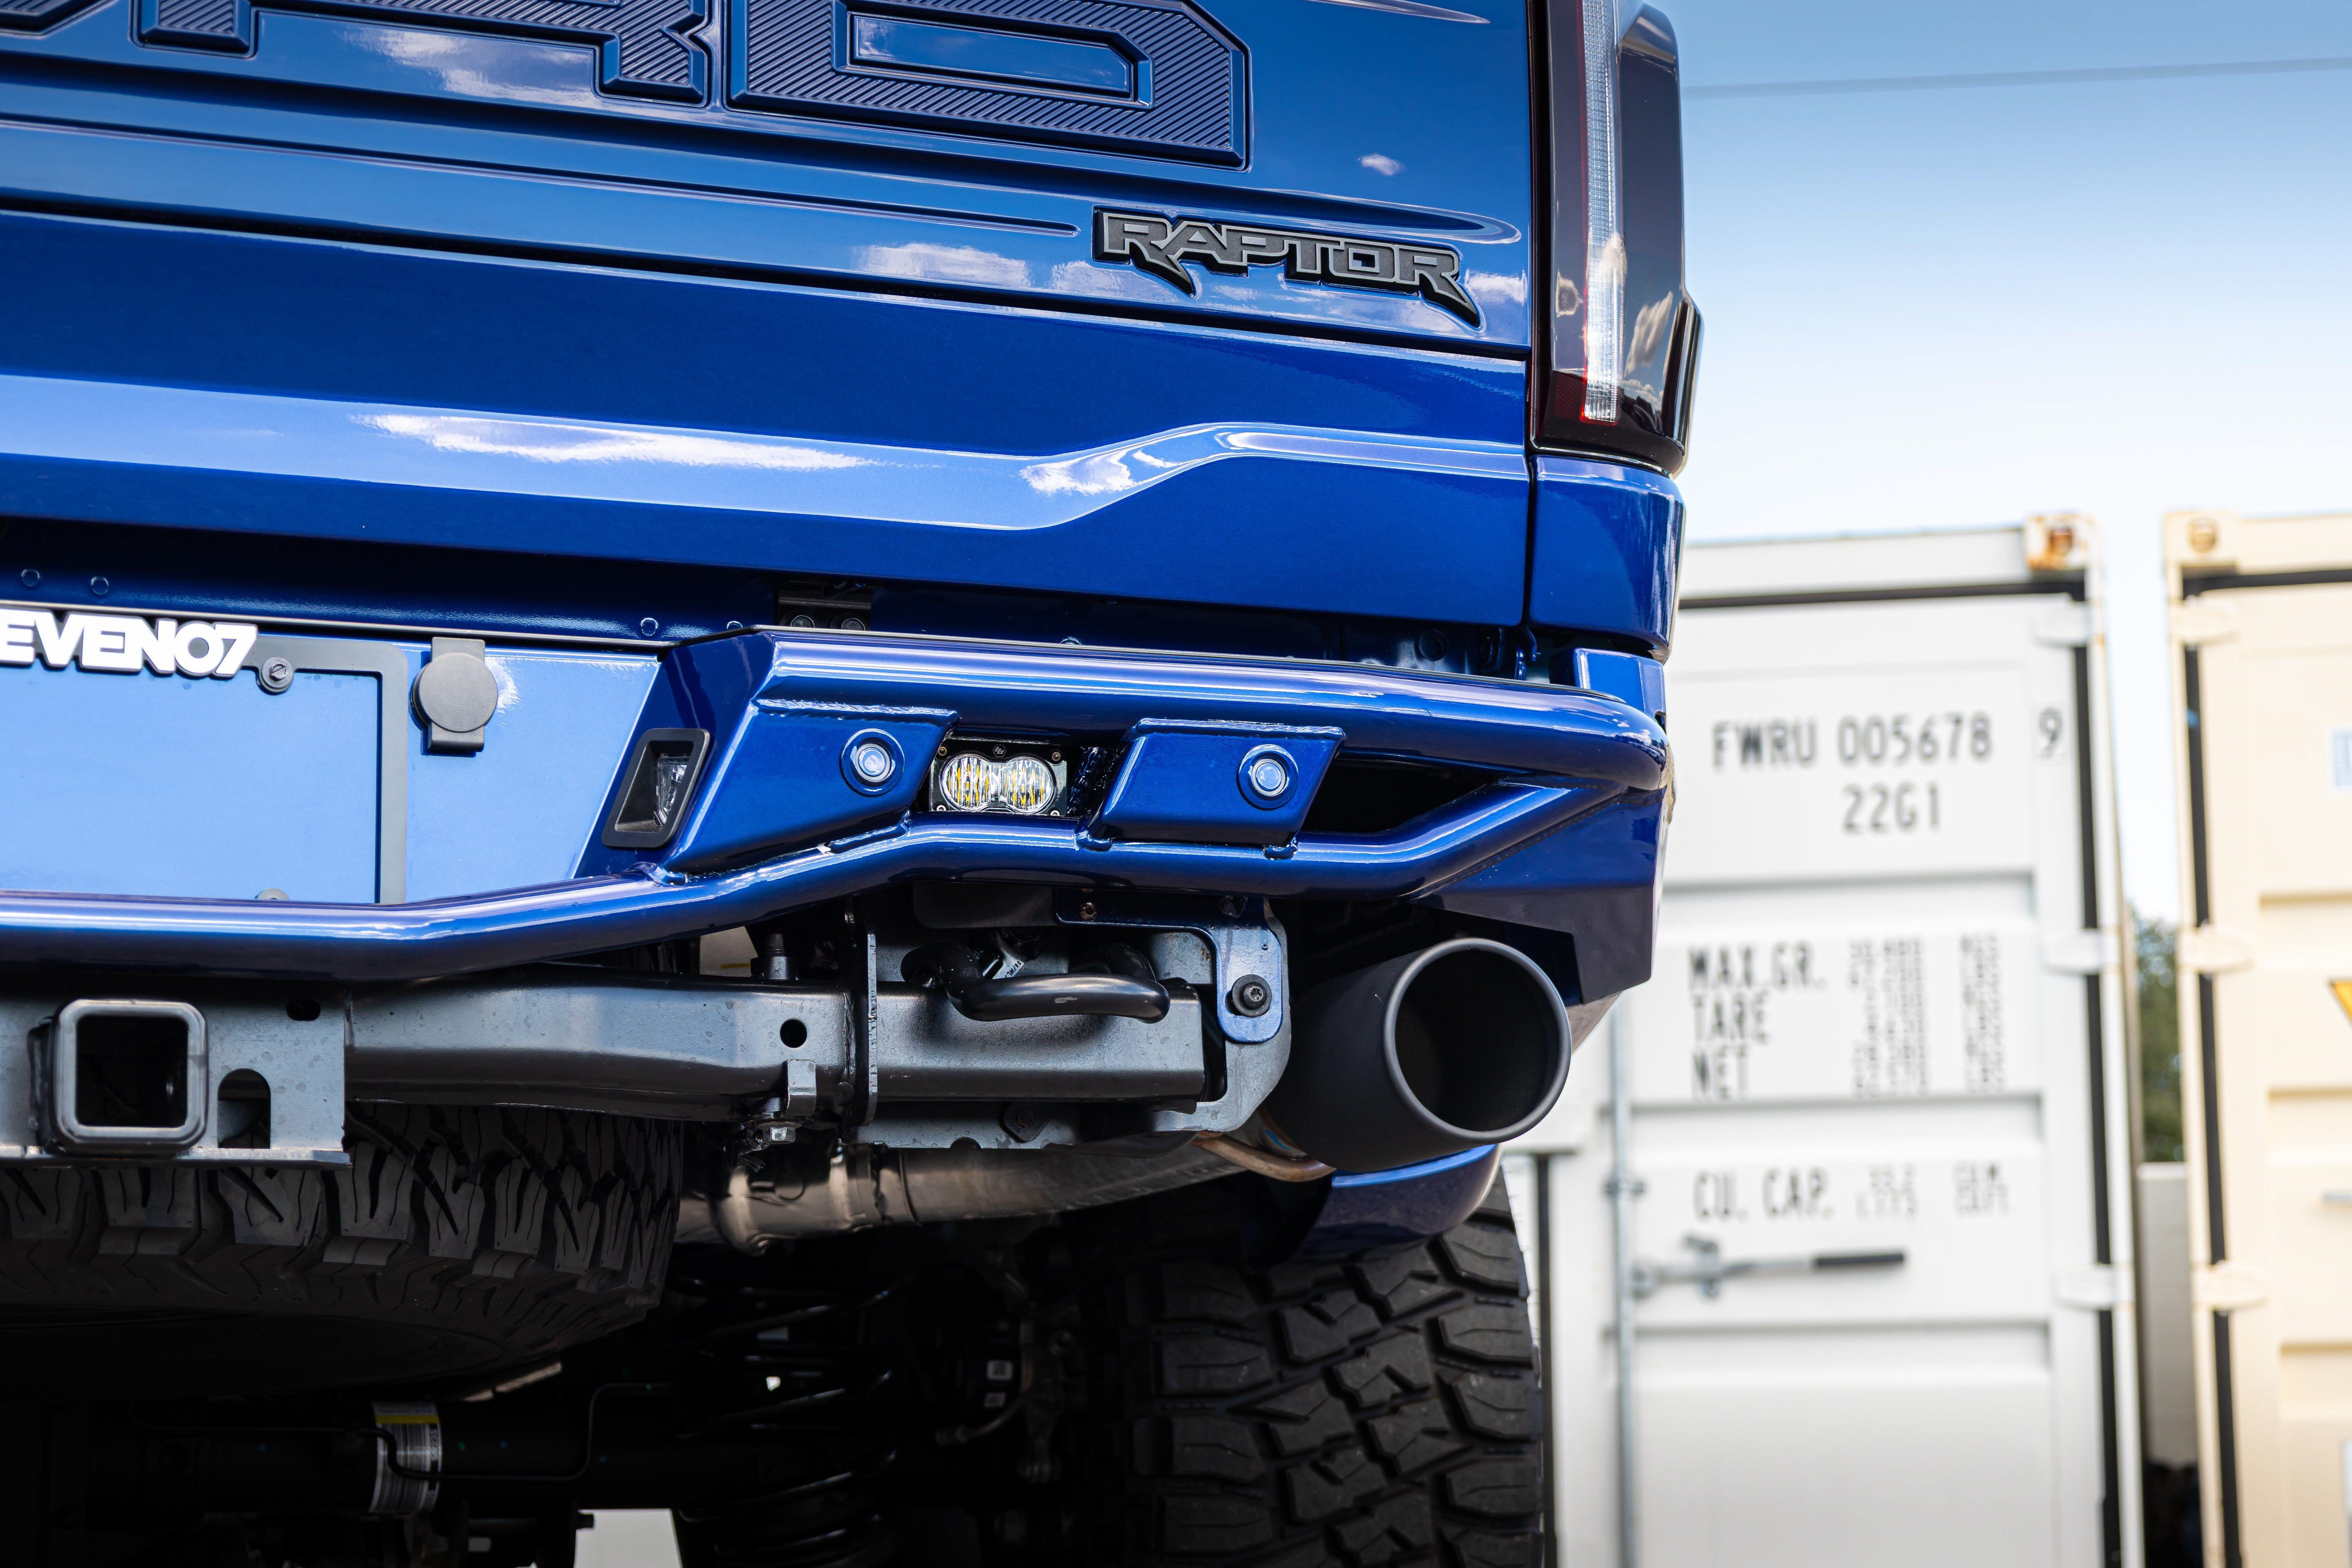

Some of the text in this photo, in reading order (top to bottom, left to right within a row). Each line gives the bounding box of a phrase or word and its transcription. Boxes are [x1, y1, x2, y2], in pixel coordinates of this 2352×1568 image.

[1094, 207, 1479, 327] RAPTOR
[1711, 707, 2064, 771] FWRU 005678 9
[1842, 782, 1941, 834] 22G1
[1691, 993, 1772, 1045] TARE
[1691, 1046, 1751, 1098] NET
